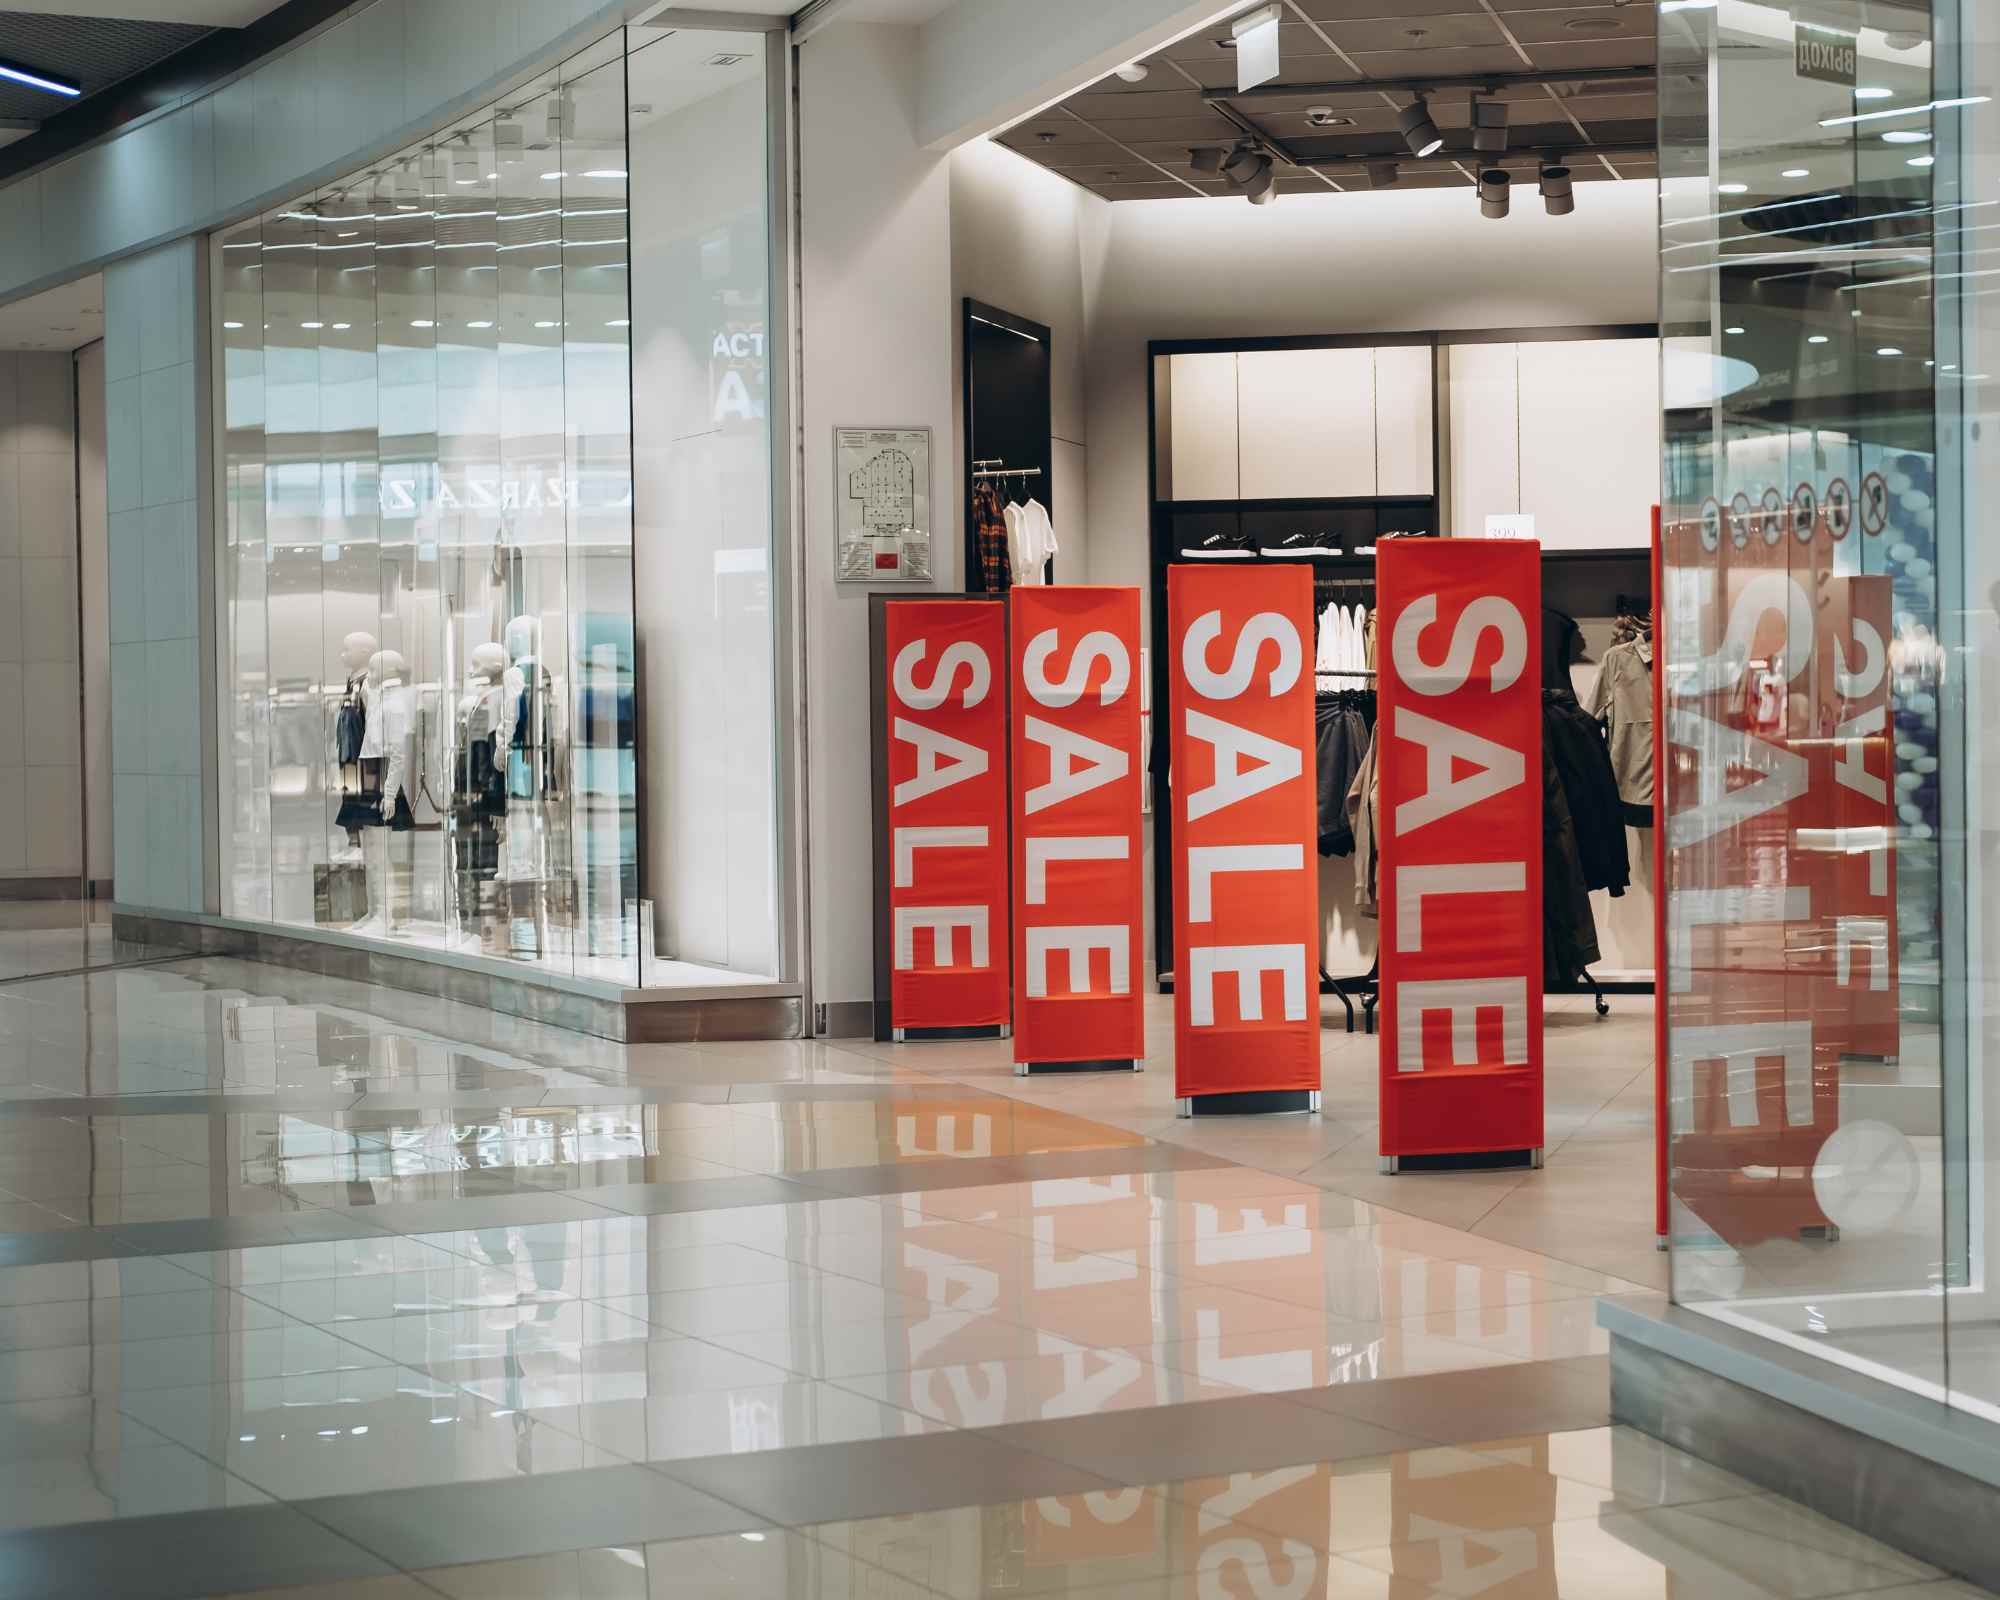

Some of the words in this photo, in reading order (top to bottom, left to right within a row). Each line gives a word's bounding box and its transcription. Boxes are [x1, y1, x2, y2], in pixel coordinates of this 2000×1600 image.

[893, 638, 991, 970] SALE
[1023, 628, 1131, 998] SALE
[1182, 609, 1308, 1027] SALE
[1392, 593, 1529, 1073] SALE
[1666, 573, 1815, 1135] SALE
